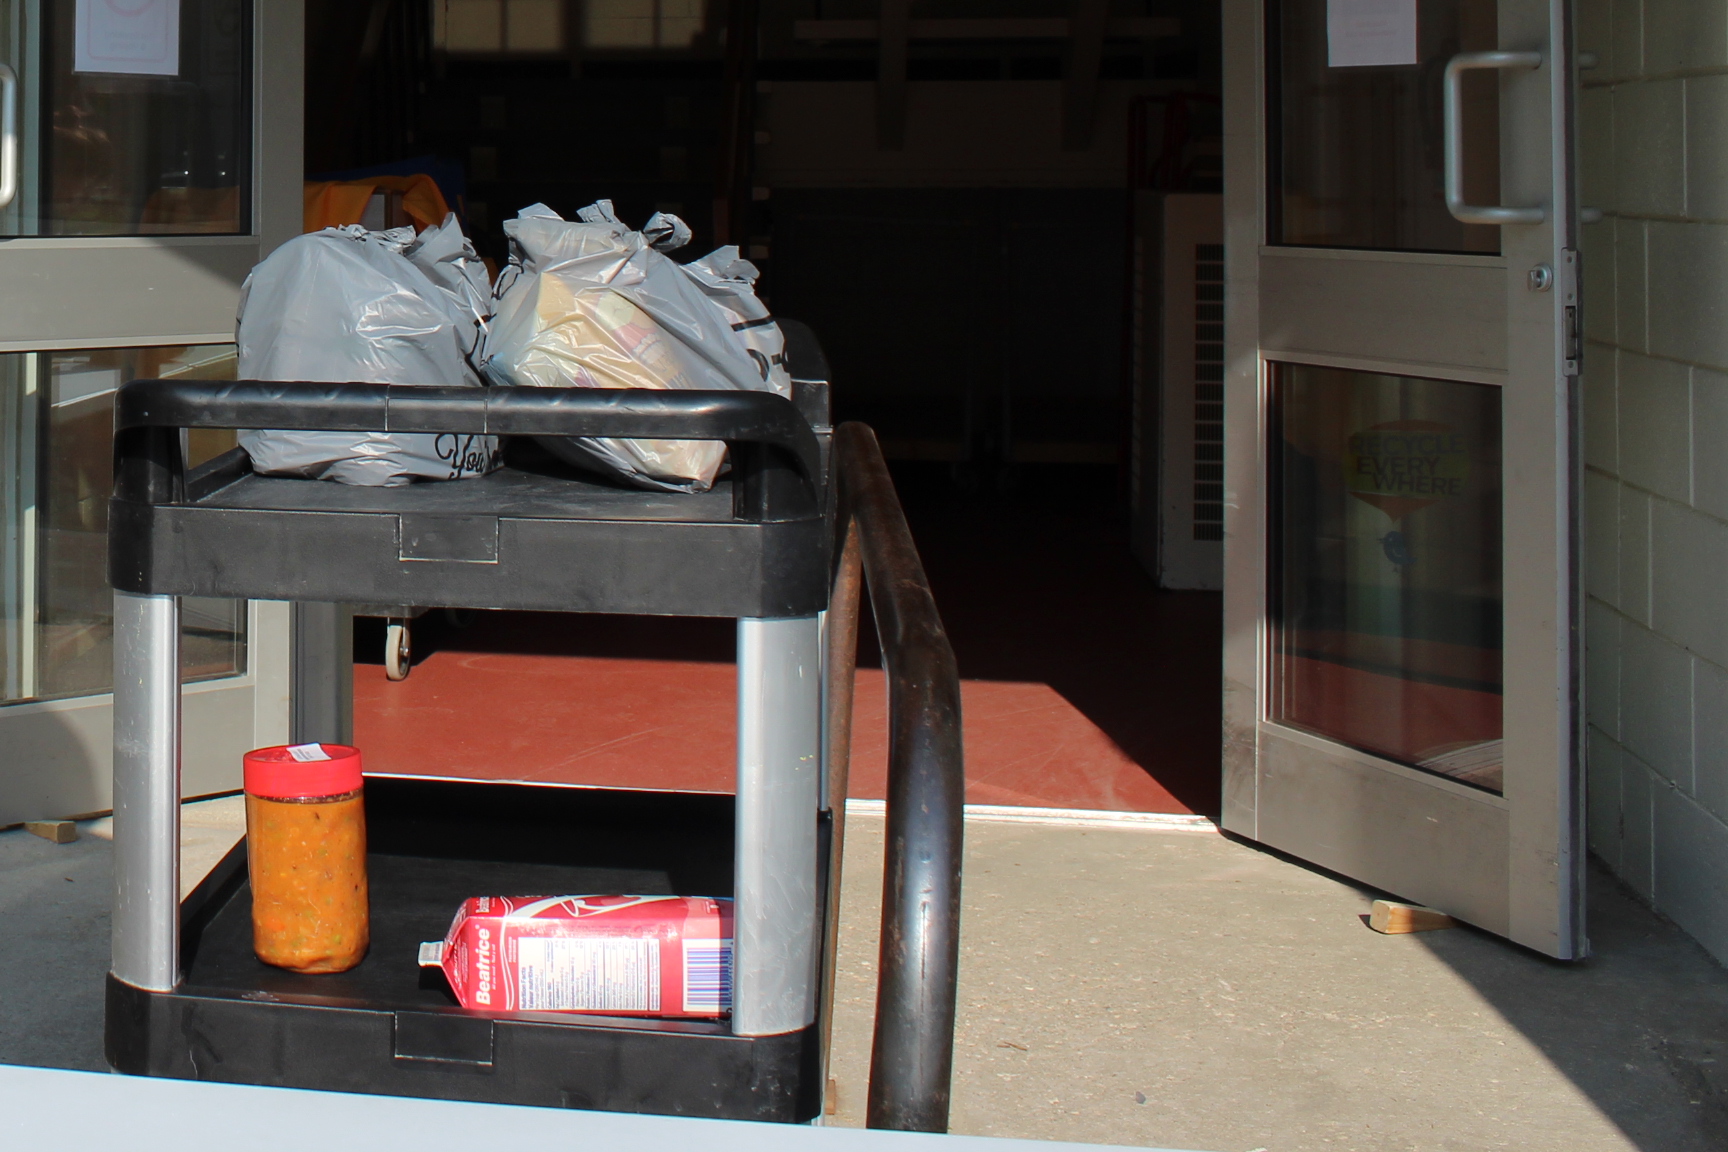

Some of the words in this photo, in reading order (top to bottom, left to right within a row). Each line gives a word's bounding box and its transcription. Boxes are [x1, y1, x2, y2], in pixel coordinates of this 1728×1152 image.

[1348, 432, 1466, 455] RECYCLE
[1356, 456, 1440, 476] EVERY
[1373, 473, 1462, 495] WHERE
[475, 928, 491, 1005] Beatrice
